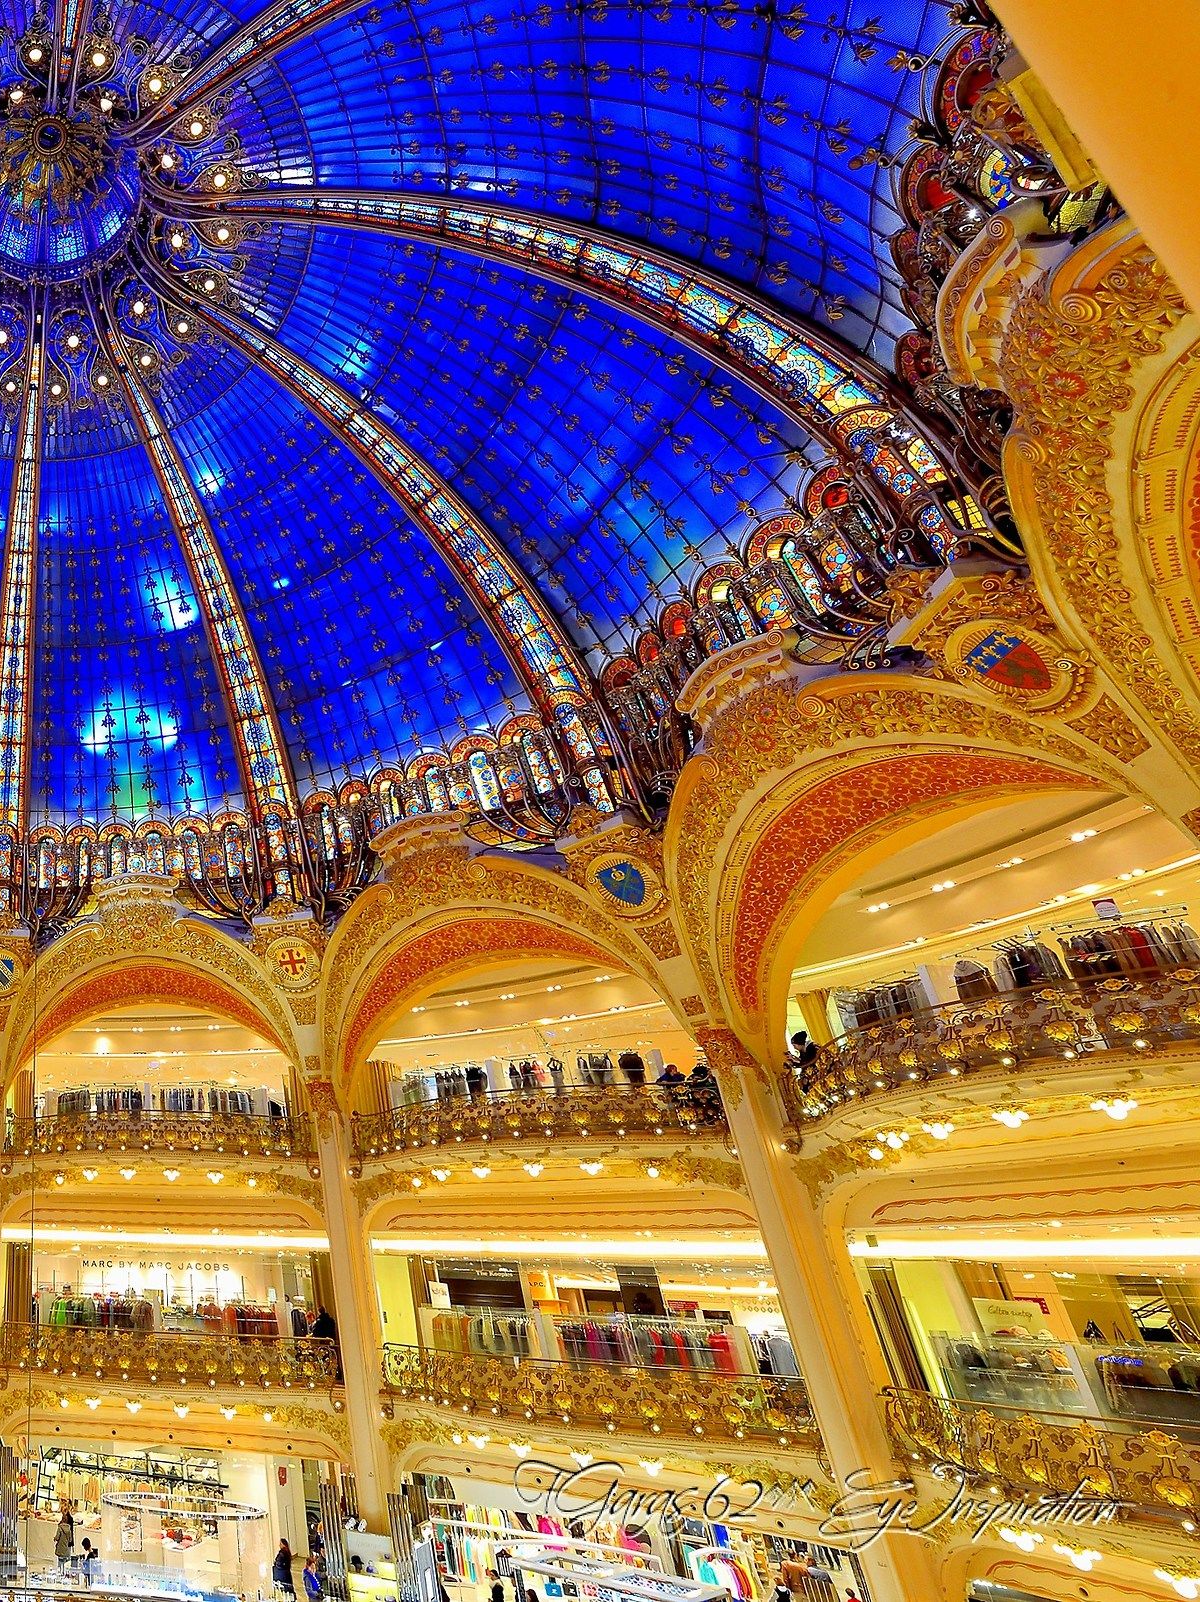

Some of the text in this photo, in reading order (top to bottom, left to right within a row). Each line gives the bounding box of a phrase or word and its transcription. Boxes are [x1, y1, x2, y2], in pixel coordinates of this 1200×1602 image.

[82, 1260, 113, 1268] MARC
[139, 1261, 172, 1270] MARC
[177, 1263, 230, 1272] JACOBS
